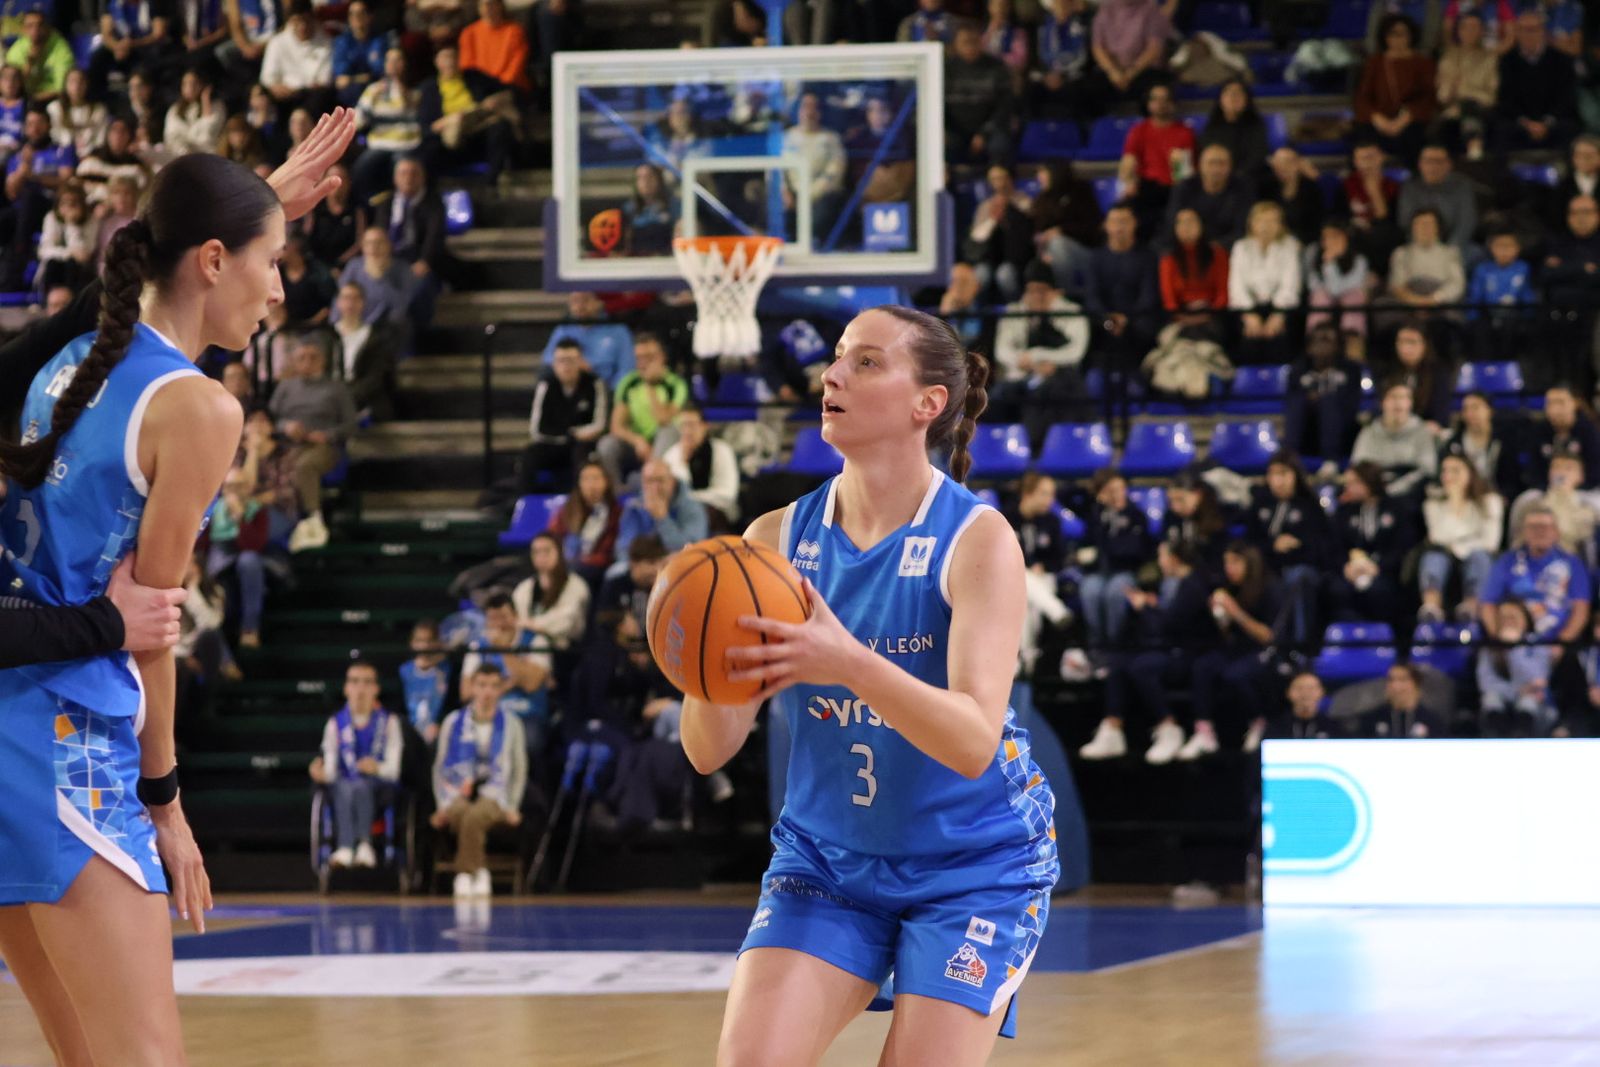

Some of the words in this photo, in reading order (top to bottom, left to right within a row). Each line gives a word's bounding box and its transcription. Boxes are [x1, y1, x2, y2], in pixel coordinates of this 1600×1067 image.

[867, 638, 879, 653] Y
[886, 632, 933, 654] LEÓN
[850, 743, 878, 807] 3
